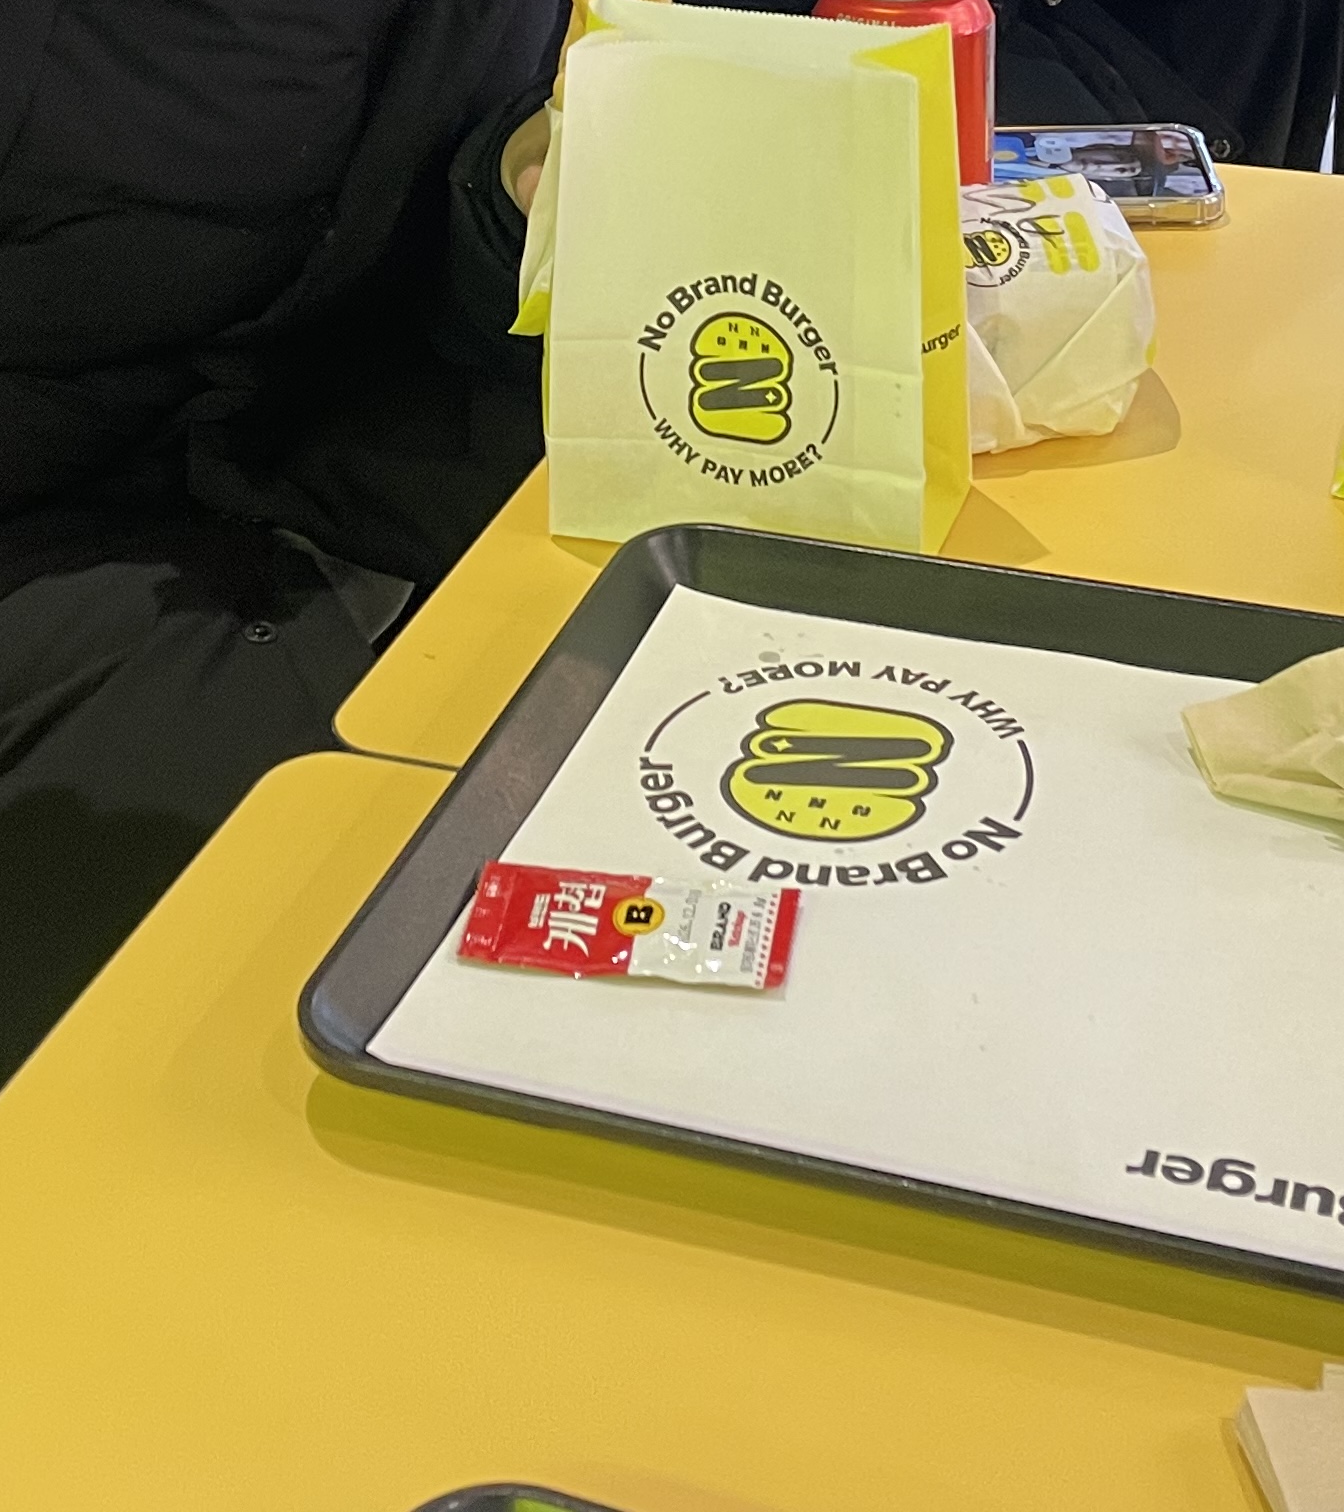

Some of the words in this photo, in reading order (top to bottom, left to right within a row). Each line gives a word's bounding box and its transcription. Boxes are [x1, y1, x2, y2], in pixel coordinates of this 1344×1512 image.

[637, 311, 676, 352] No
[666, 273, 758, 315] Brand
[761, 279, 839, 376] Burger
[653, 418, 700, 465] WHY
[700, 457, 745, 486] PAY
[748, 443, 823, 487] MORE?
[718, 660, 862, 694] MORE?
[873, 665, 952, 694] PAY
[949, 688, 1025, 740] WHY
[639, 756, 751, 873] Burger
[941, 817, 1023, 862] No
[748, 851, 948, 886] Brand
